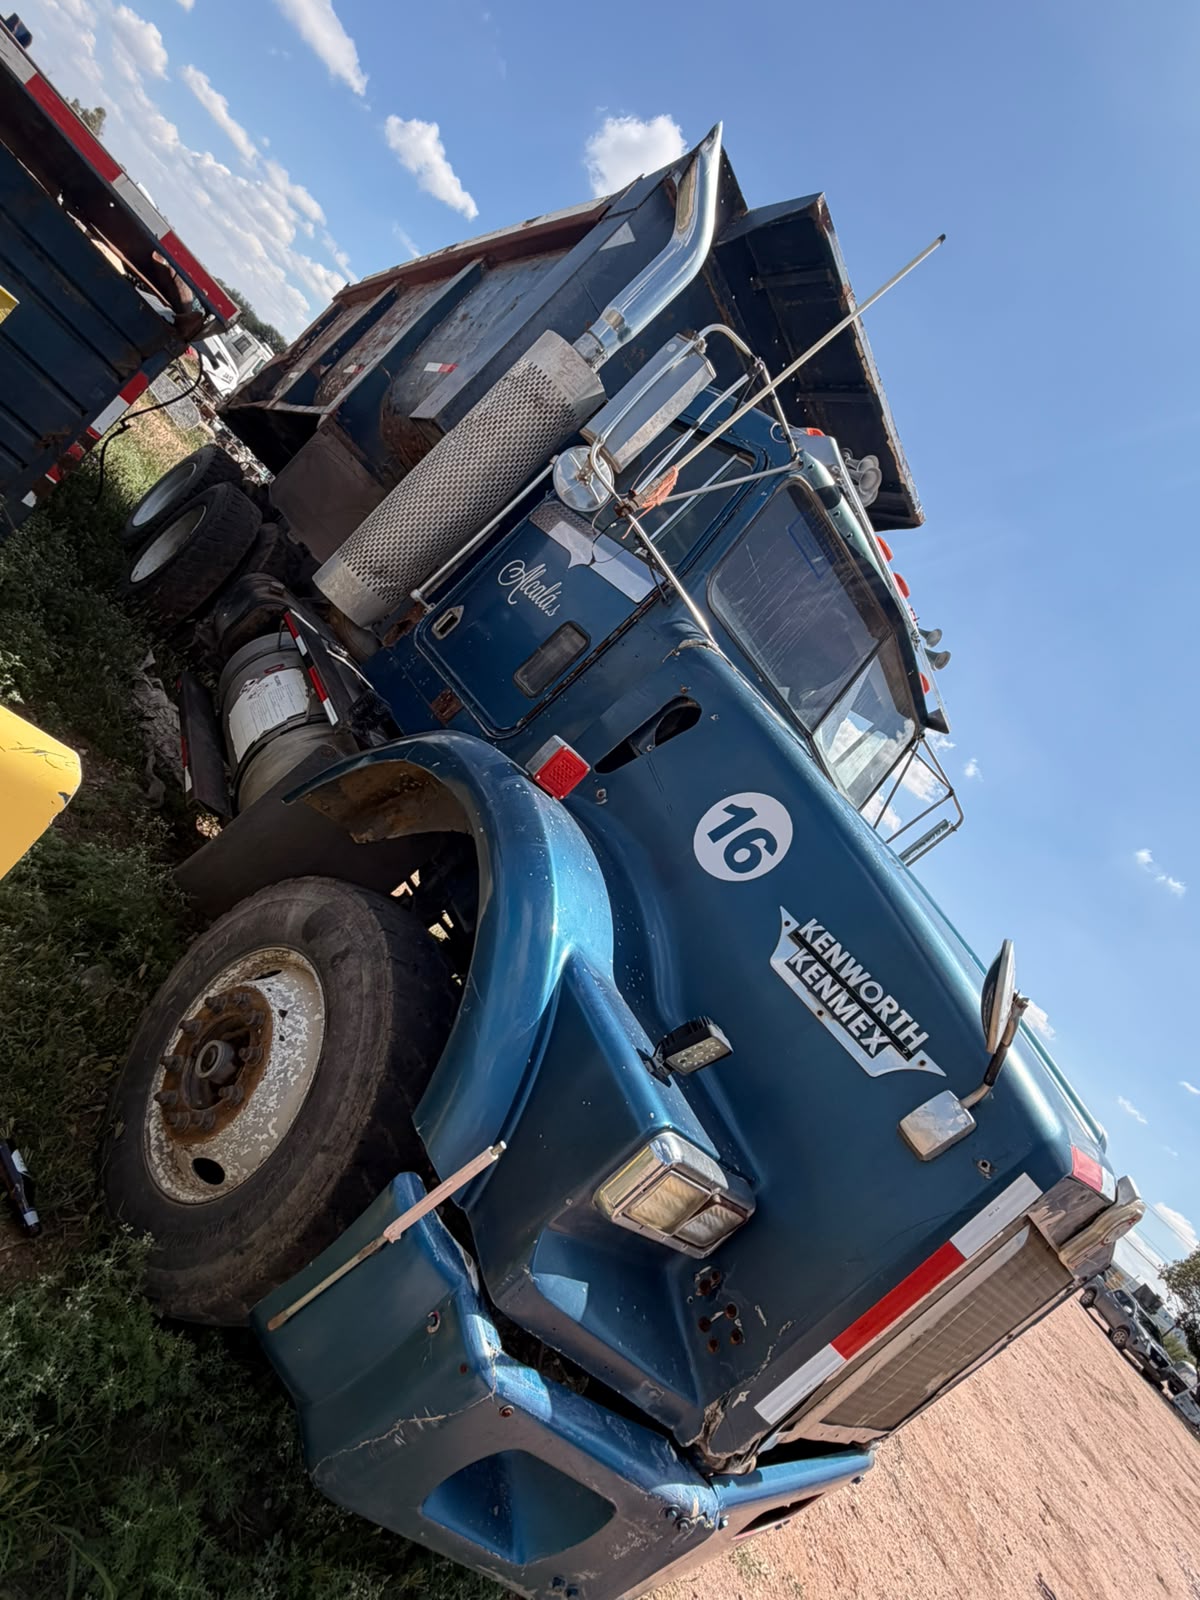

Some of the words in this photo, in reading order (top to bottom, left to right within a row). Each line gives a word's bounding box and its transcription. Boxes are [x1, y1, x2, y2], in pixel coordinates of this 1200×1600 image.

[707, 803, 778, 874] 16
[788, 948, 893, 1057] KENMEX
[798, 918, 929, 1051] KENWORTH
